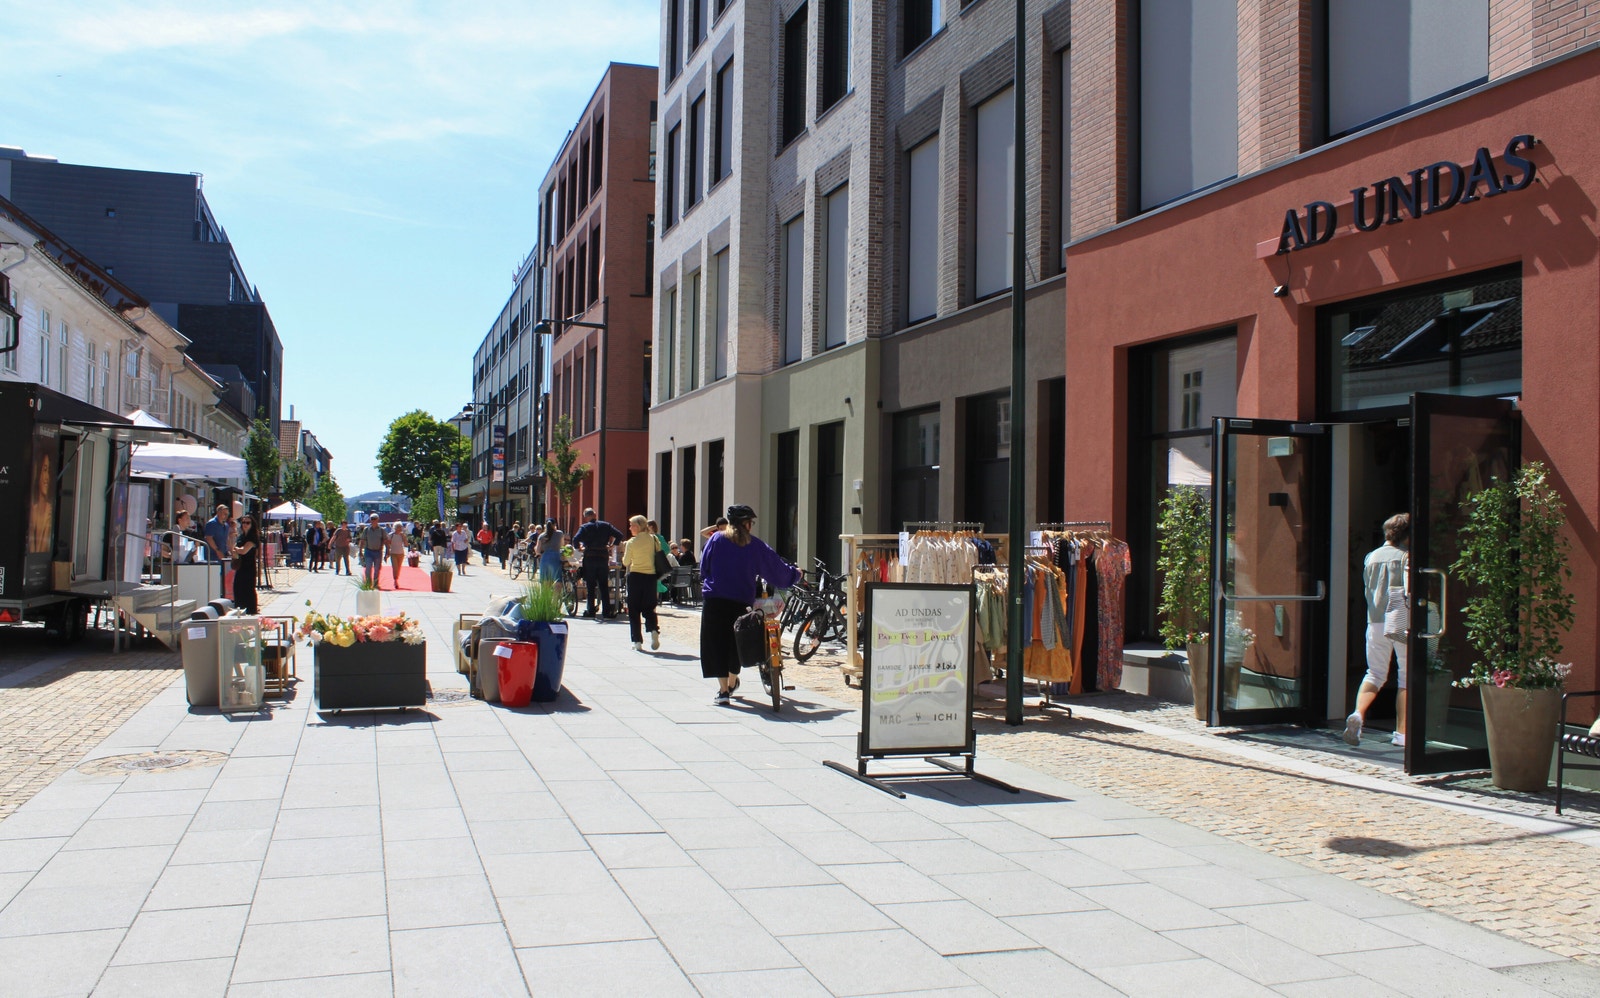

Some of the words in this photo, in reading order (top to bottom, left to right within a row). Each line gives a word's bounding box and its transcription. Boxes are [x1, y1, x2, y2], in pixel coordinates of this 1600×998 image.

[1276, 201, 1337, 255] AD
[1350, 135, 1536, 232] UNDAS
[895, 608, 908, 617] AD
[911, 608, 942, 617] UNDAS
[880, 714, 902, 724] MAC
[933, 713, 957, 721] ICHI
